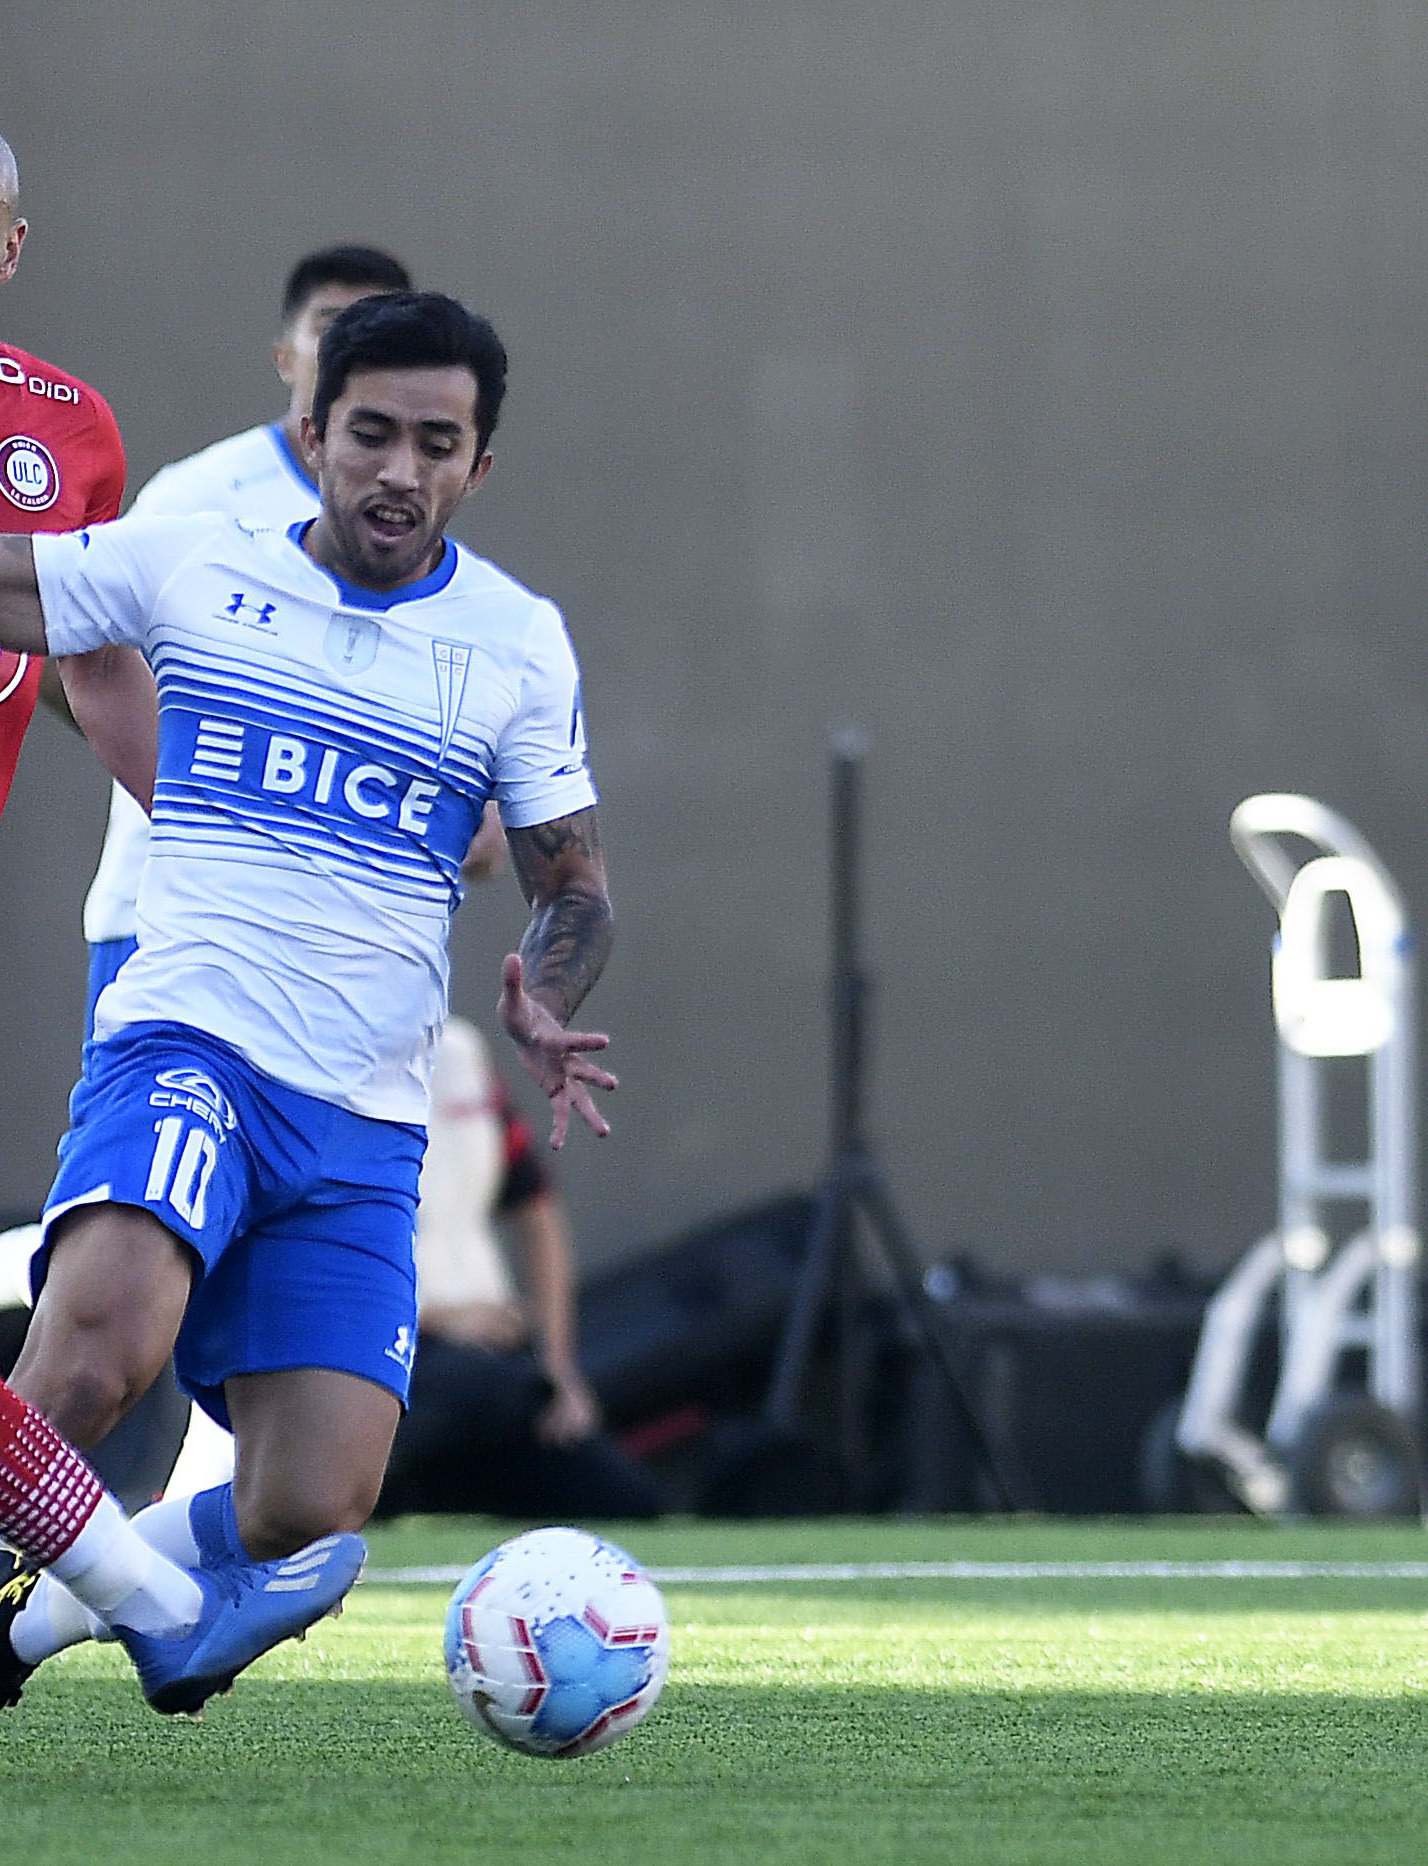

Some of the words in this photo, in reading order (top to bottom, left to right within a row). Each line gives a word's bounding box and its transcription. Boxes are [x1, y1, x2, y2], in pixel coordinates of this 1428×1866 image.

[12, 460, 43, 485] ULC
[262, 735, 440, 835] BICE
[144, 1116, 217, 1230] 10
